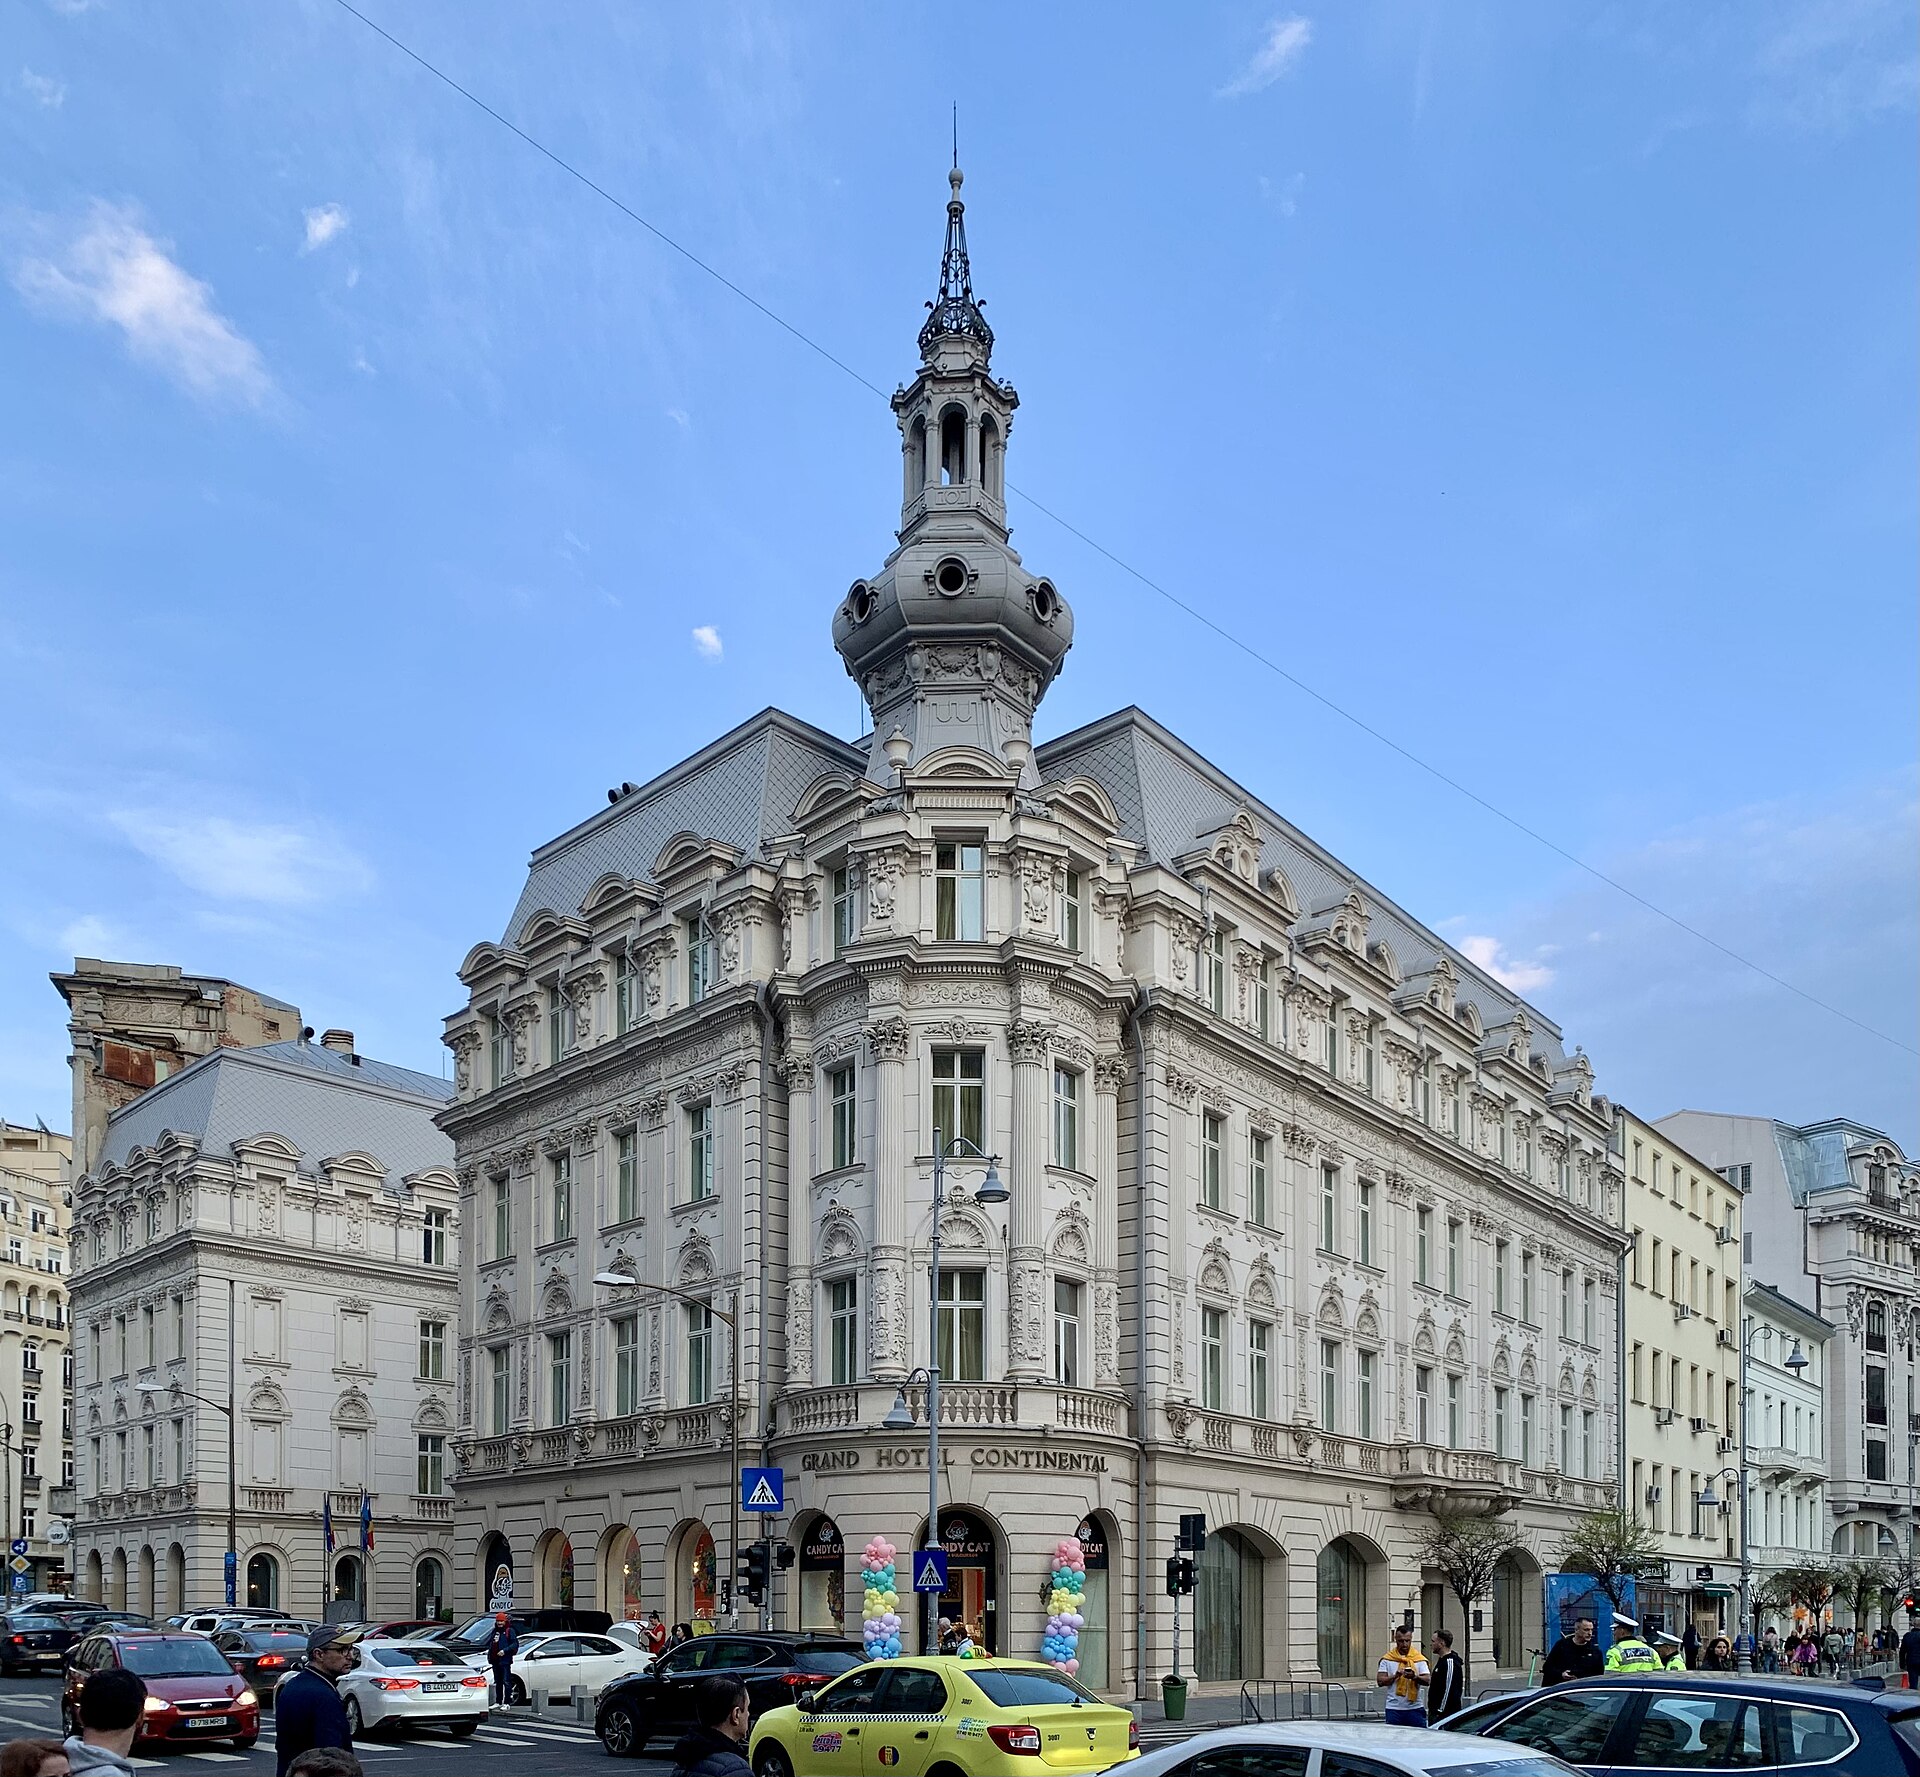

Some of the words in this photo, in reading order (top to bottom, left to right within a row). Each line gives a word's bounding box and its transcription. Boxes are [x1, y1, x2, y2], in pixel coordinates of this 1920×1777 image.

[802, 1450, 860, 1471] GRAND
[970, 1448, 1109, 1473] CONTINENTAL
[806, 1544, 832, 1555] CANDY
[967, 1542, 991, 1552] CAT
[1090, 1543, 1103, 1553] CAT
